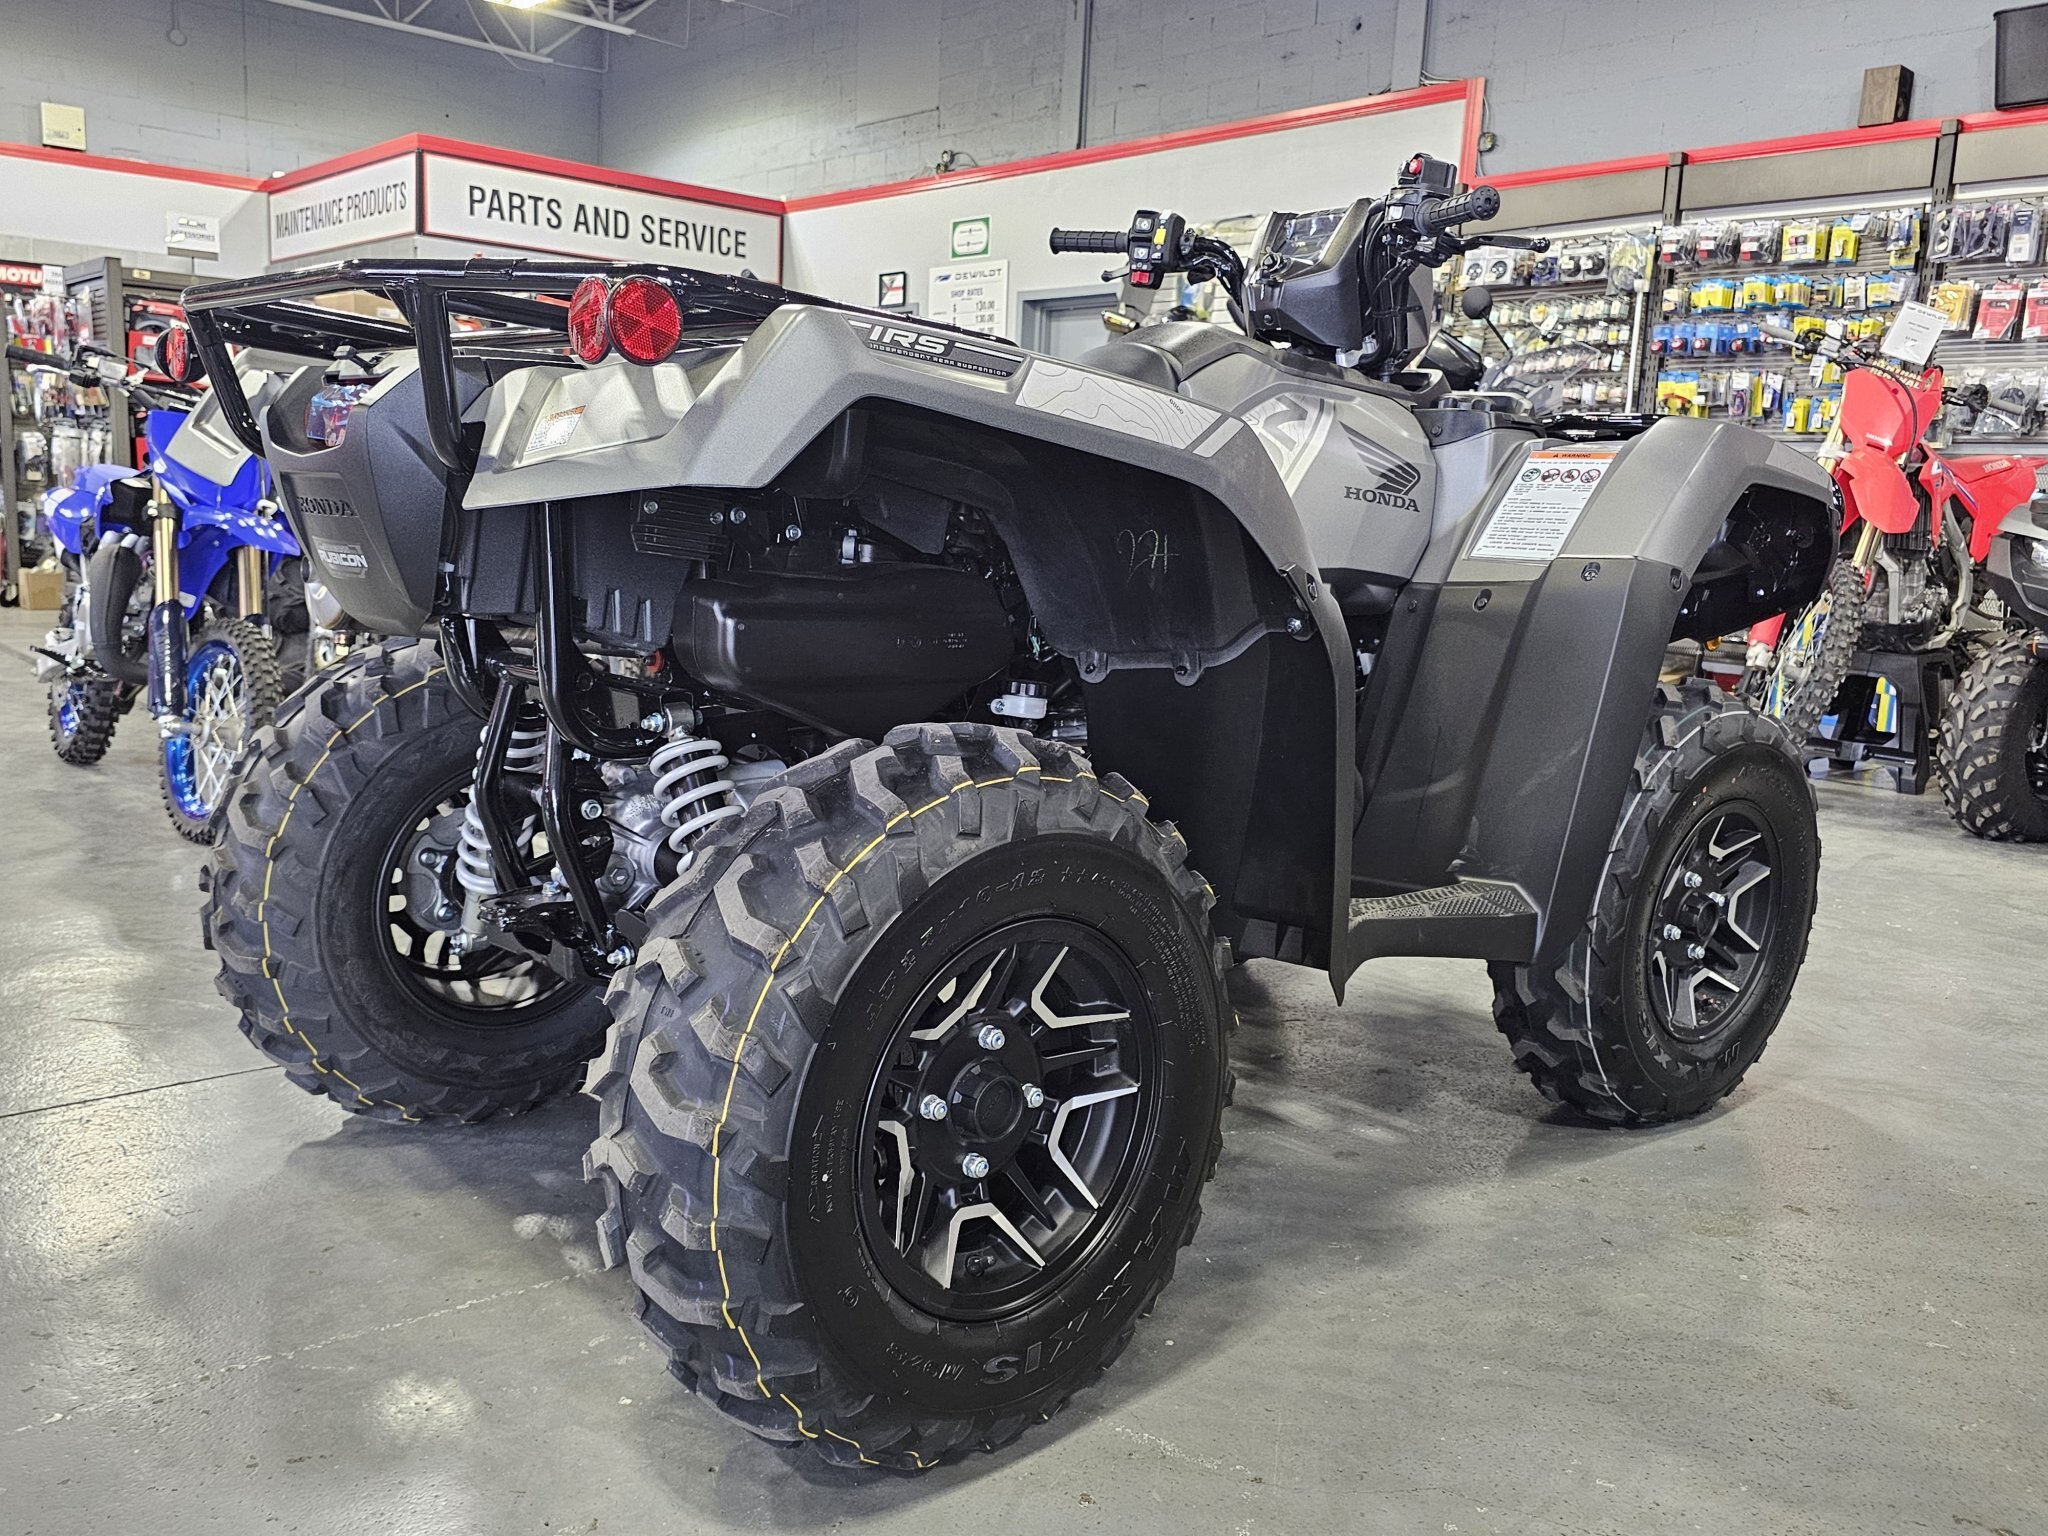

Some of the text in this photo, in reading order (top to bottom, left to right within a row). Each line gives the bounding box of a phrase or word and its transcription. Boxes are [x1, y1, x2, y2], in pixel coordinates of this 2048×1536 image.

[275, 182, 408, 240] MAINTENANCE PRODUCTS
[469, 185, 748, 259] PARTS AND SERVICE
[0, 265, 43, 285] OTU
[954, 268, 1002, 281] DEWILDT
[869, 325, 950, 355] IRS
[869, 343, 1007, 377] INDEPENDENT REAR SUSPENSION
[296, 496, 359, 517] HONDA
[1343, 485, 1421, 513] HONDA
[317, 549, 369, 568] RUBICON
